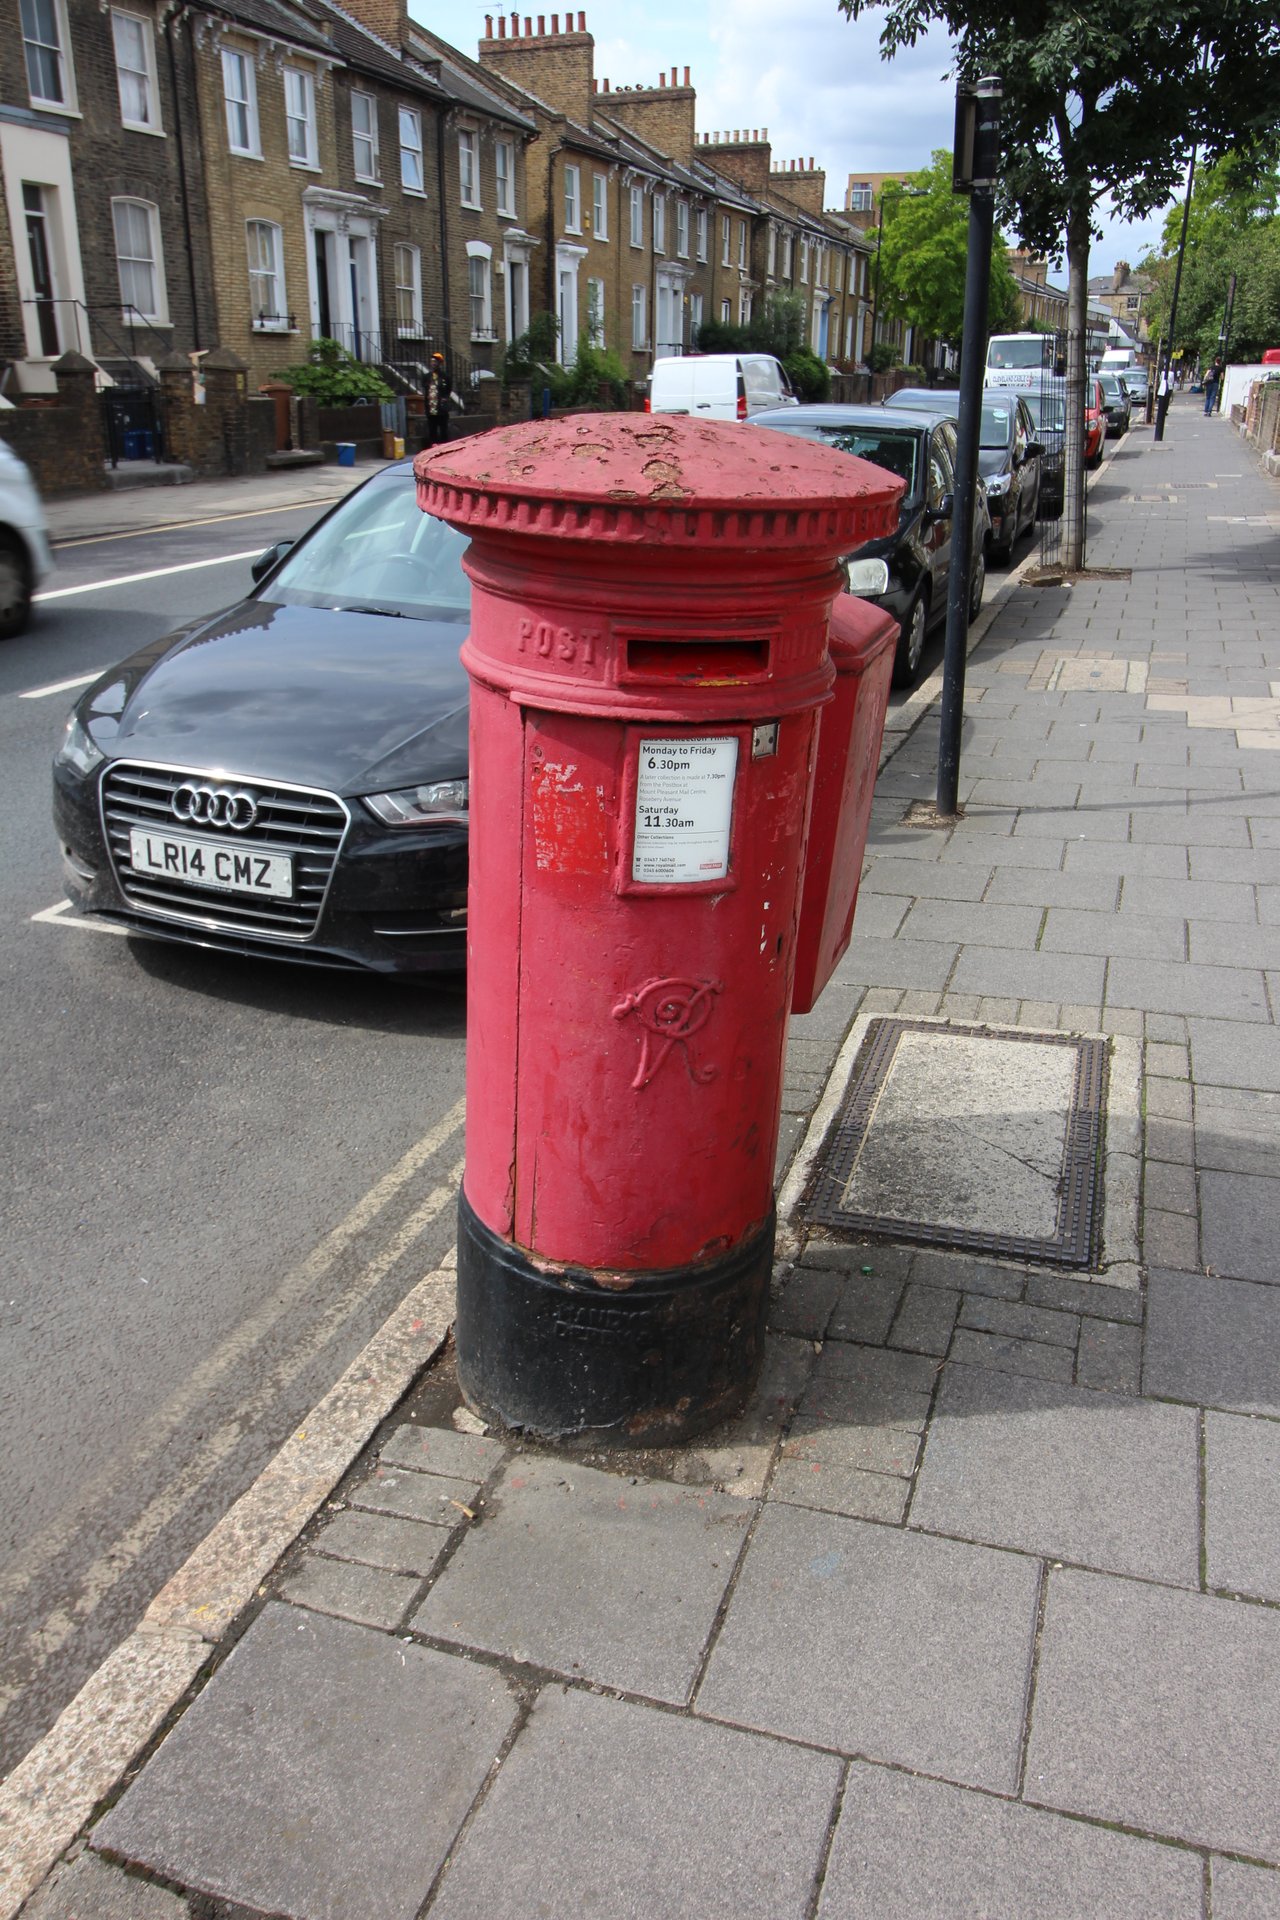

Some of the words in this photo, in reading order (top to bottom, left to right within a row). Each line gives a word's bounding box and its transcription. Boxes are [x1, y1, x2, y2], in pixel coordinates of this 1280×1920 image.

[517, 618, 601, 667] POST
[642, 746, 677, 756] Monday
[690, 746, 717, 756] Friday
[648, 757, 690, 771] 6.30pm
[638, 805, 679, 815] Saturday
[644, 815, 694, 828] 11.30am
[146, 838, 206, 877] LR14
[214, 851, 272, 889] CMZ
